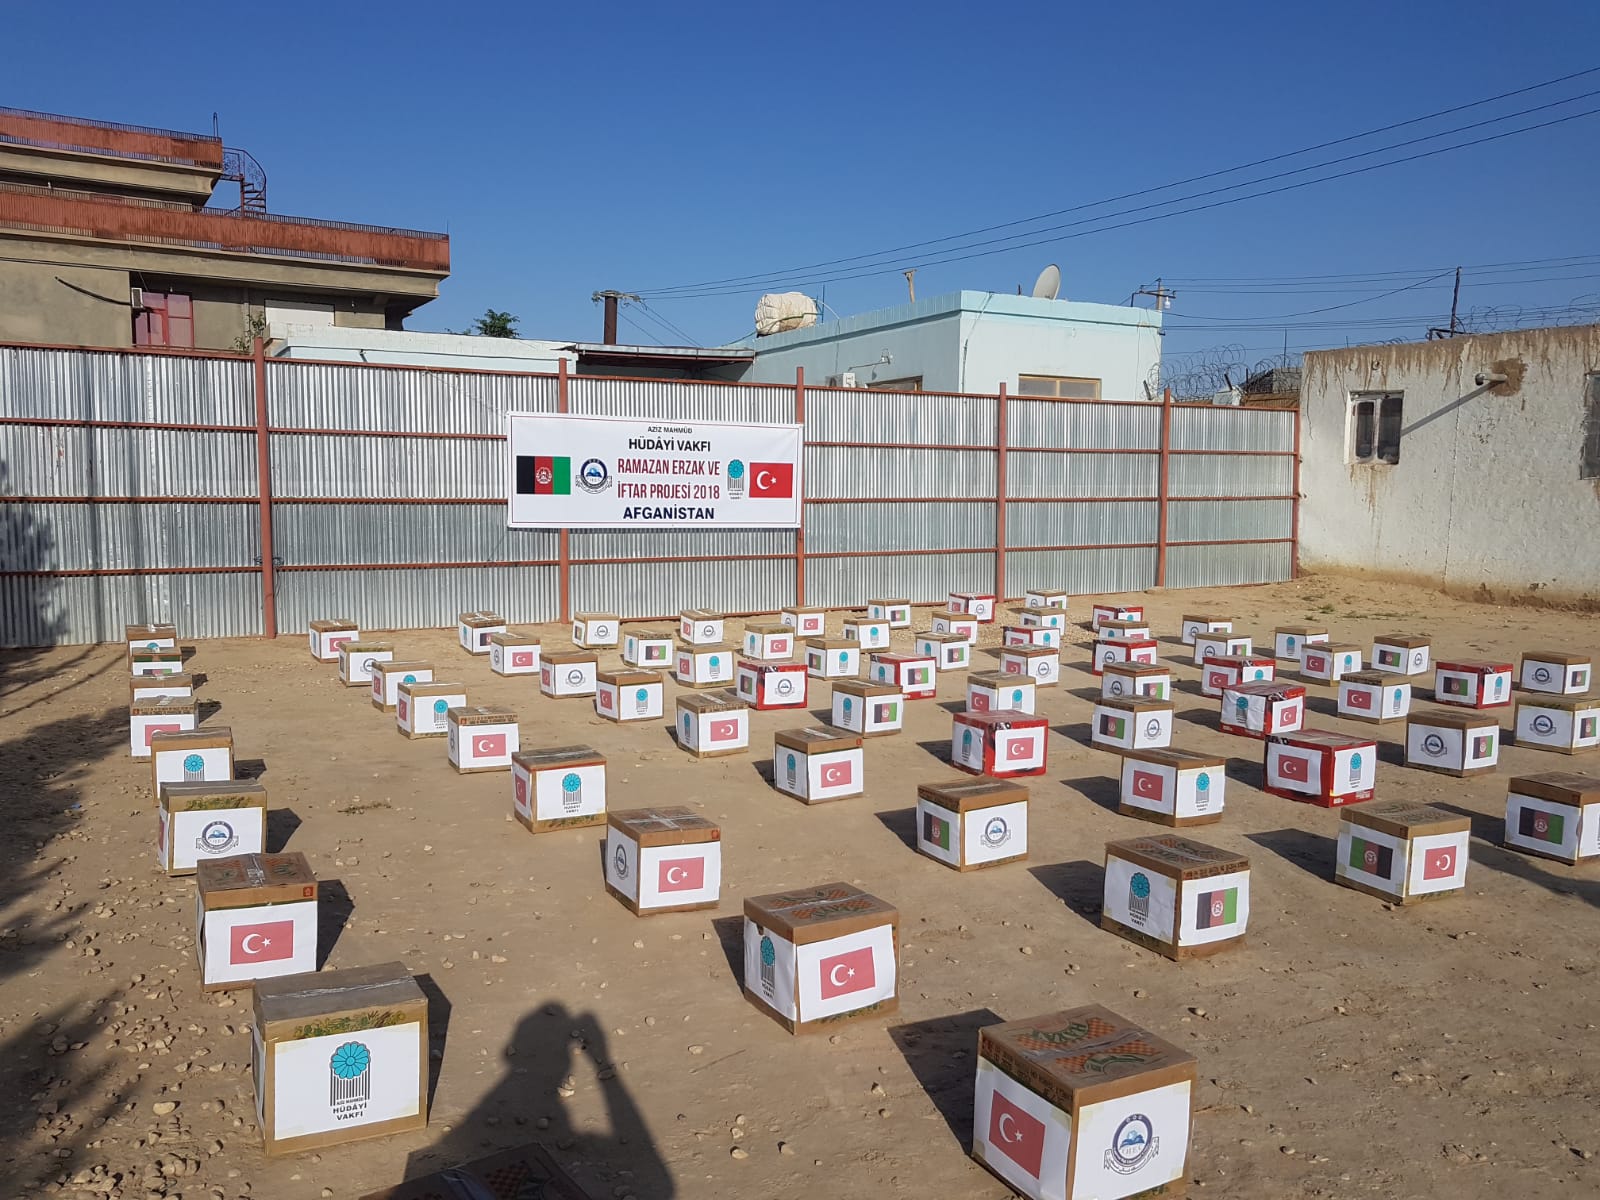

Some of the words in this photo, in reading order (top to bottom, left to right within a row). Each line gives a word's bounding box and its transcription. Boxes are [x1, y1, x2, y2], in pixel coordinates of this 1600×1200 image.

[628, 435, 675, 451] HÜDÂYİ
[677, 440, 711, 452] VAKFI
[617, 458, 670, 475] RAMAZAN
[672, 460, 705, 476] ERZAK
[707, 461, 720, 476] VE
[617, 481, 647, 499] İFTAR
[649, 482, 691, 499] PROJESİ
[693, 484, 720, 500] 2018
[622, 504, 715, 520] AFGANİSTAN
[336, 1111, 363, 1120] VAKFI
